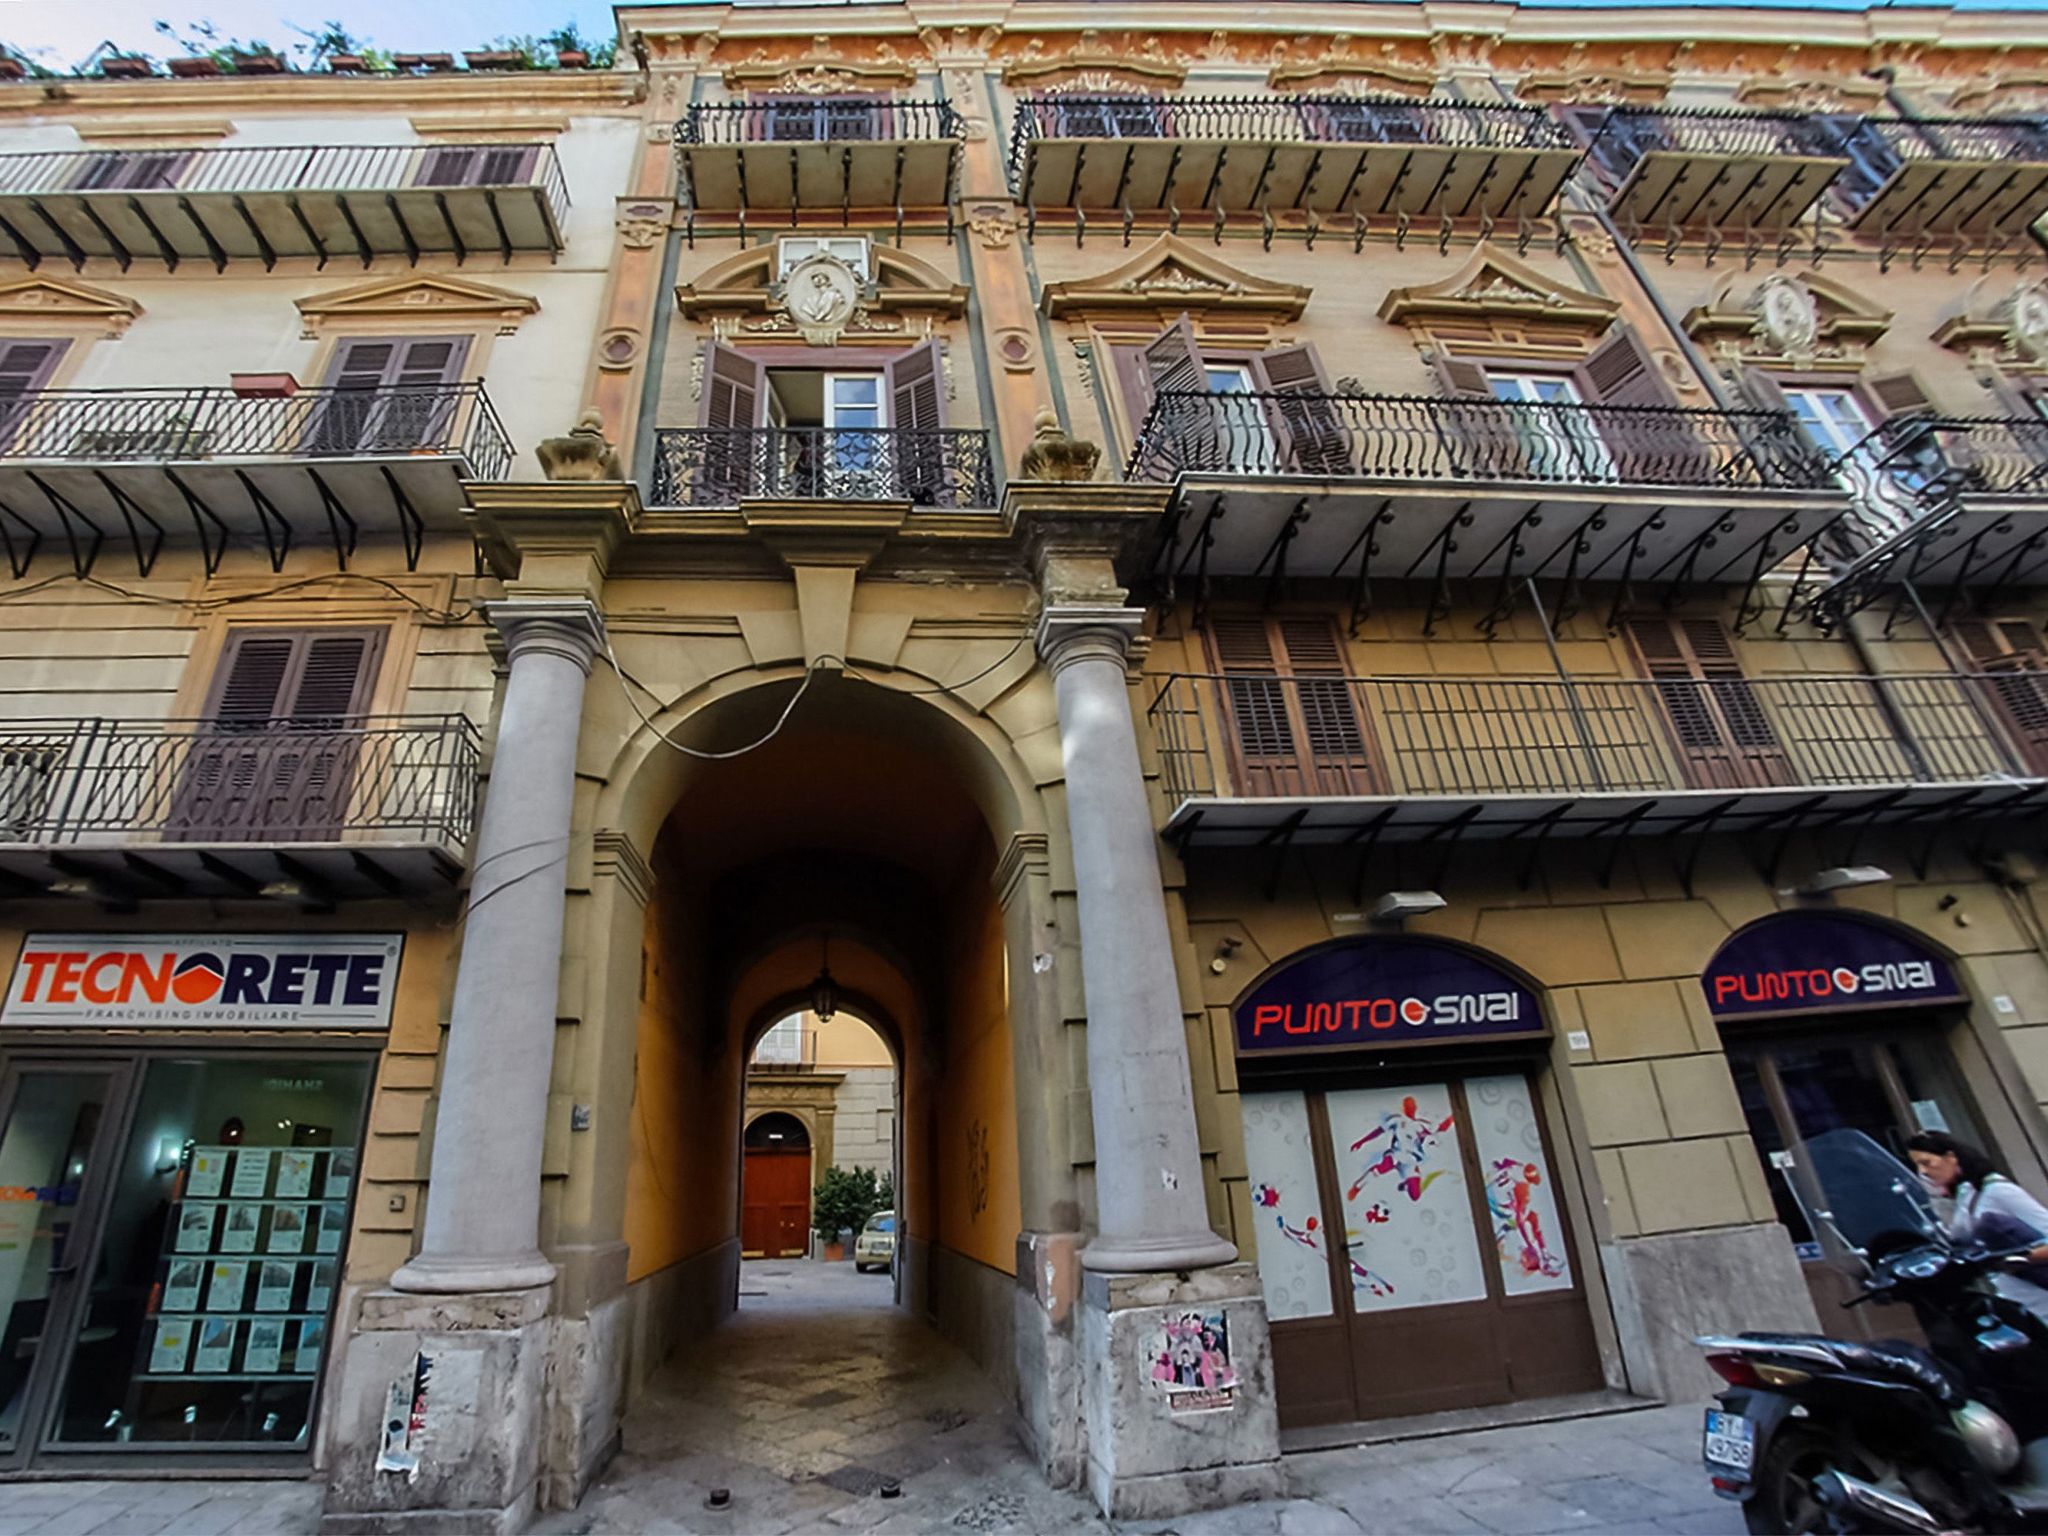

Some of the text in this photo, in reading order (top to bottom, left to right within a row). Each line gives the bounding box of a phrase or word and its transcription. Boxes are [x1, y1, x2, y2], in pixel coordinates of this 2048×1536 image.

[1714, 968, 1833, 1004] PUNTO
[83, 1010, 300, 1021] FRANCHISING IMMOBILIARE
[1253, 999, 1397, 1037] PUNTO
